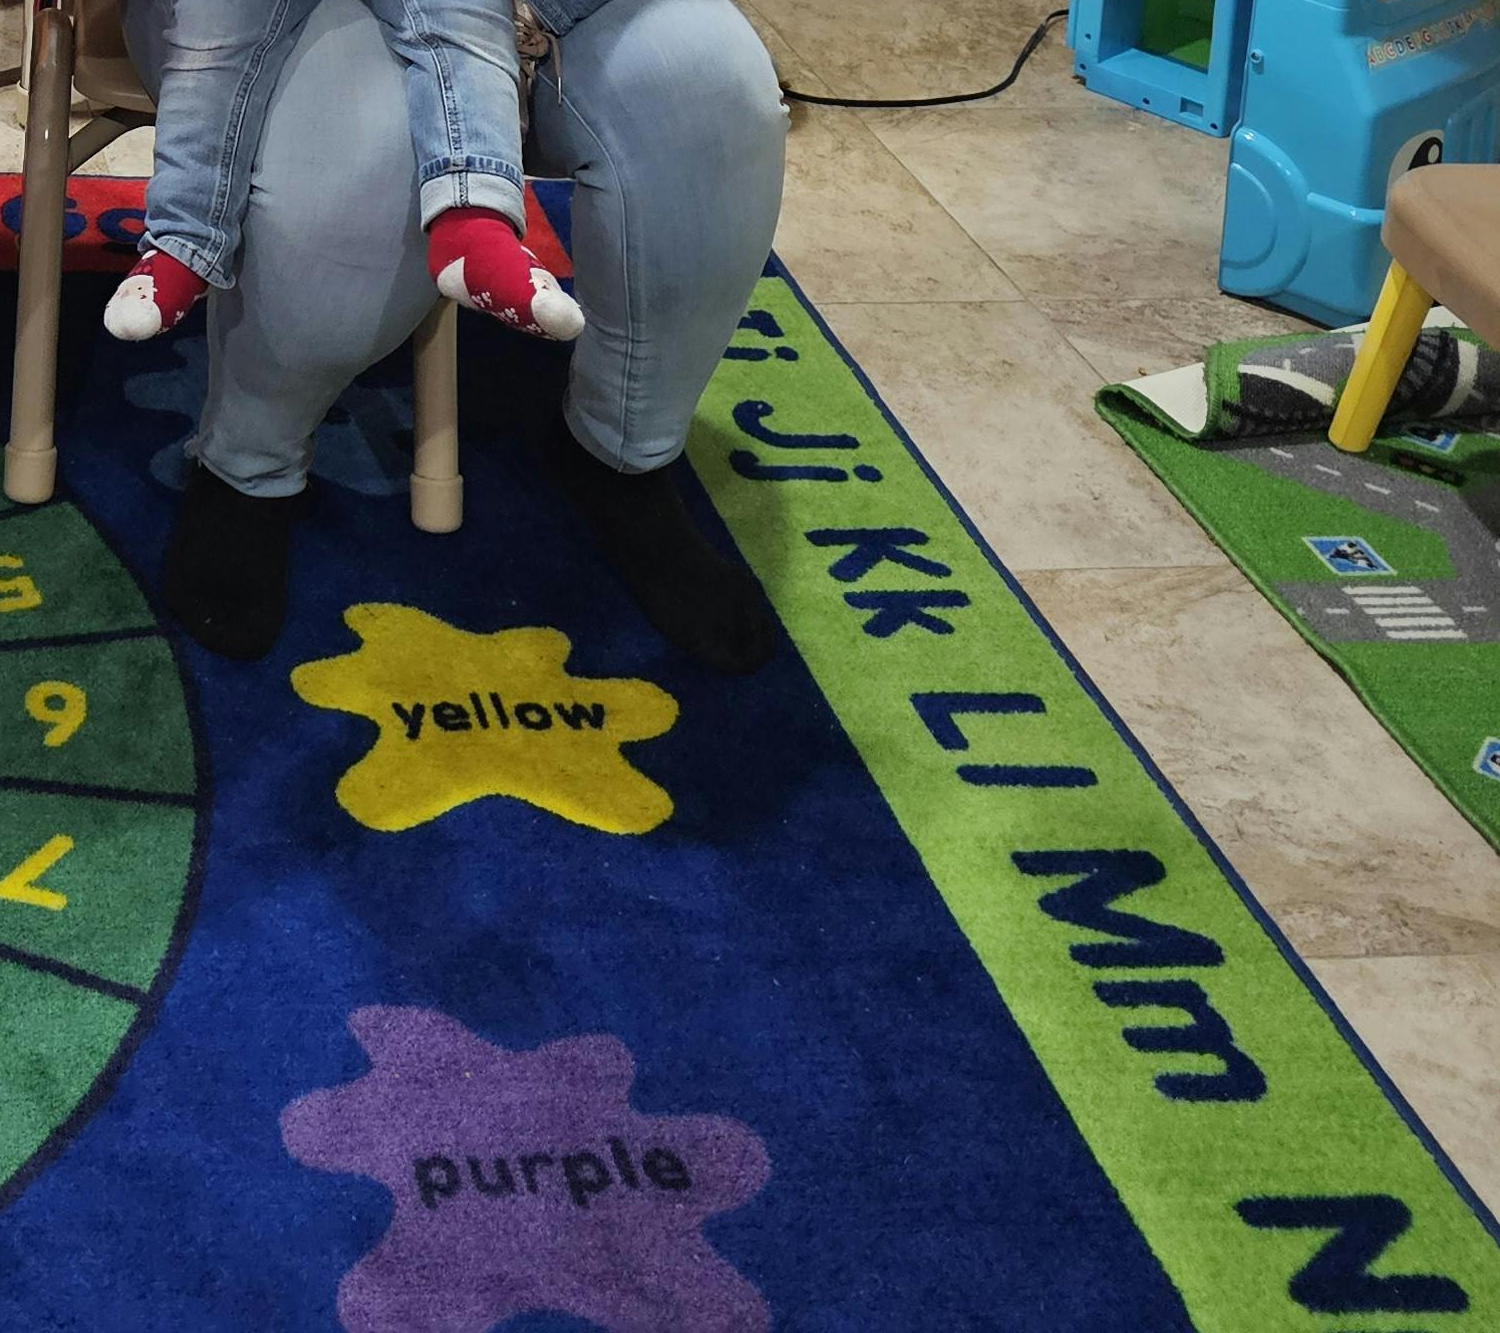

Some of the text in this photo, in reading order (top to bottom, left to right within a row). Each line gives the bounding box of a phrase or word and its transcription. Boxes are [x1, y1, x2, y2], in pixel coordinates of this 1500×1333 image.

[802, 526, 974, 638] Kk
[392, 691, 607, 741] yellow
[1010, 848, 1268, 1103] Mm
[413, 1138, 694, 1210] purple
